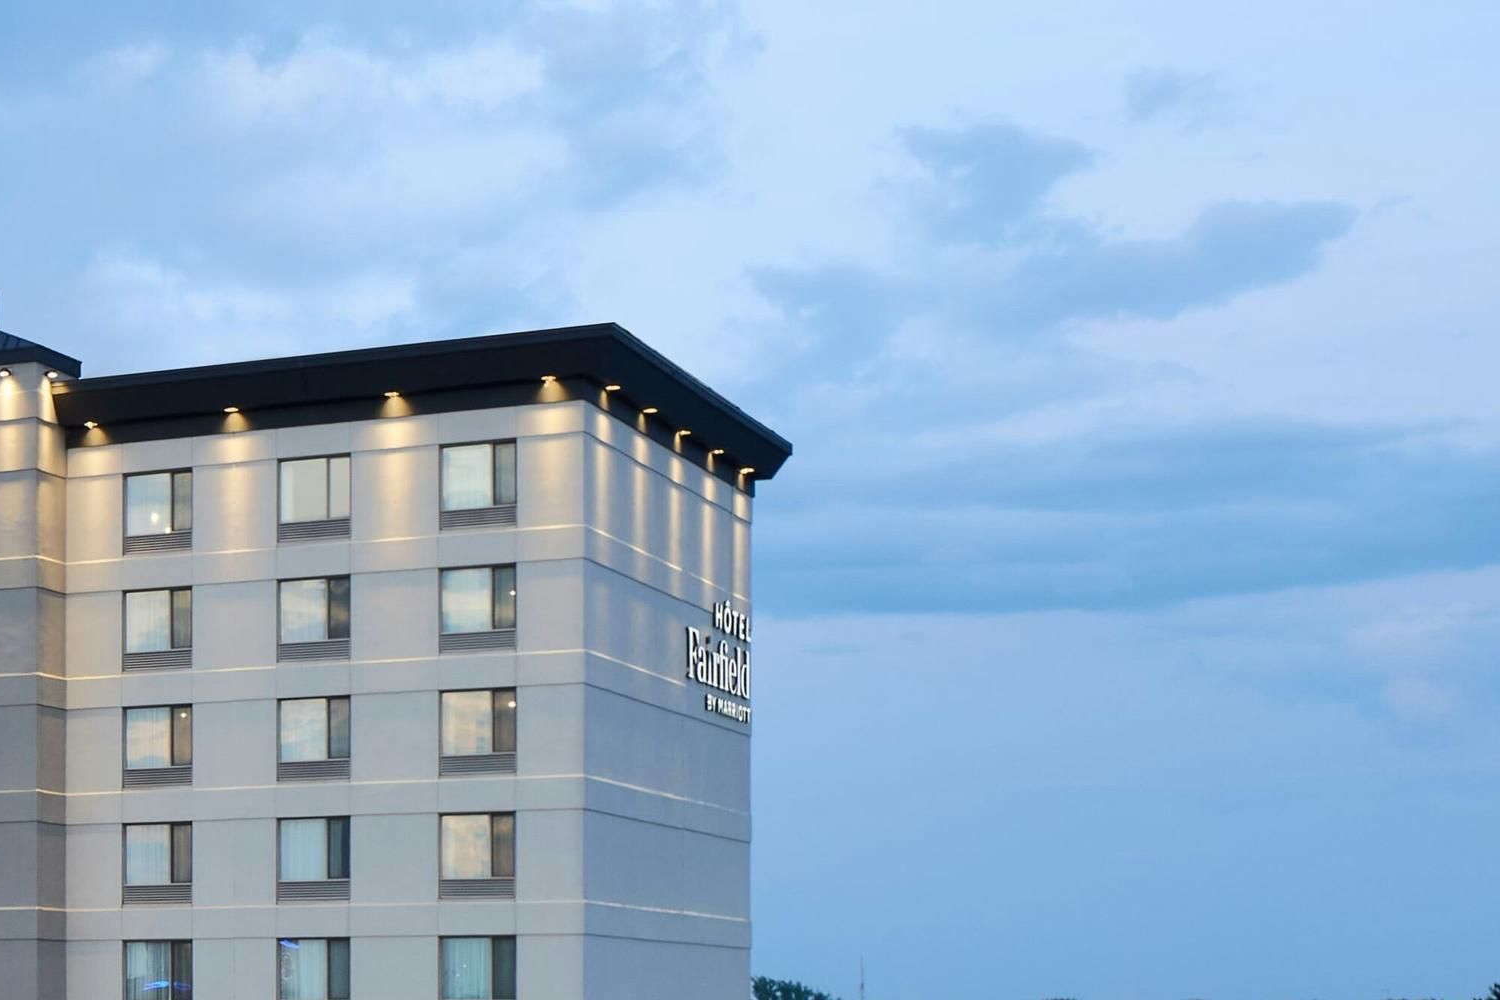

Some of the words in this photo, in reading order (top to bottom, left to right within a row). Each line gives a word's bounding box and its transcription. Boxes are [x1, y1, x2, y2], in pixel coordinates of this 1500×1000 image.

[714, 600, 752, 643] HÔTEL
[686, 626, 750, 700] Fairfield
[705, 693, 719, 712] BY
[717, 697, 752, 724] MARRIOTT
